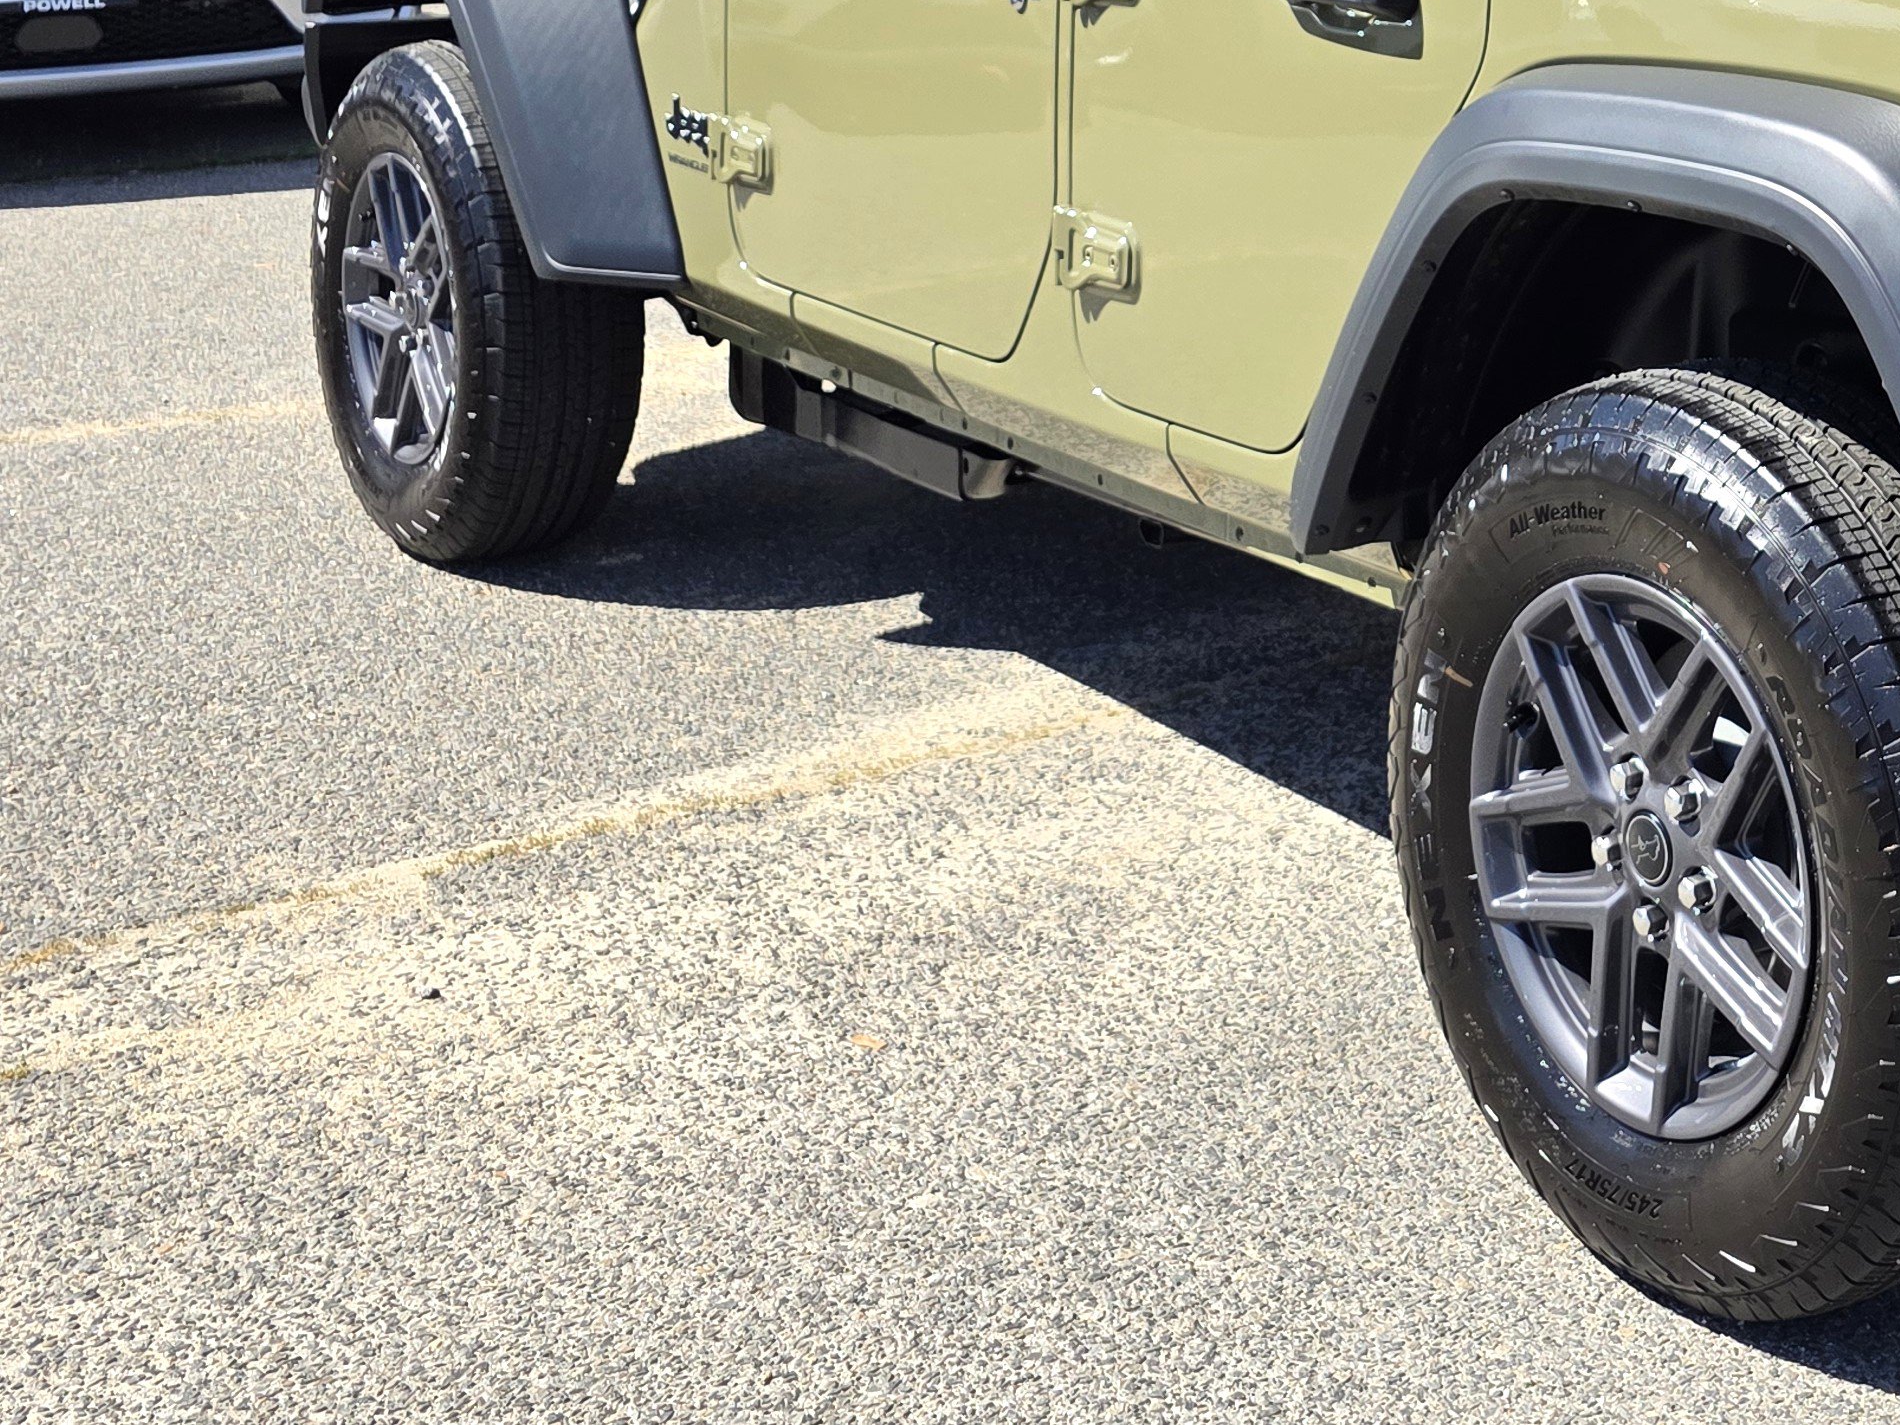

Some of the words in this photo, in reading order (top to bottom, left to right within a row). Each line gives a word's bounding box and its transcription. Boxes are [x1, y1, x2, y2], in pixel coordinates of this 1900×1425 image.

[1509, 501, 1606, 538] All-Weather
[1411, 648, 1454, 941] NEXEN
[1565, 1158, 1664, 1220] 245/75R17
